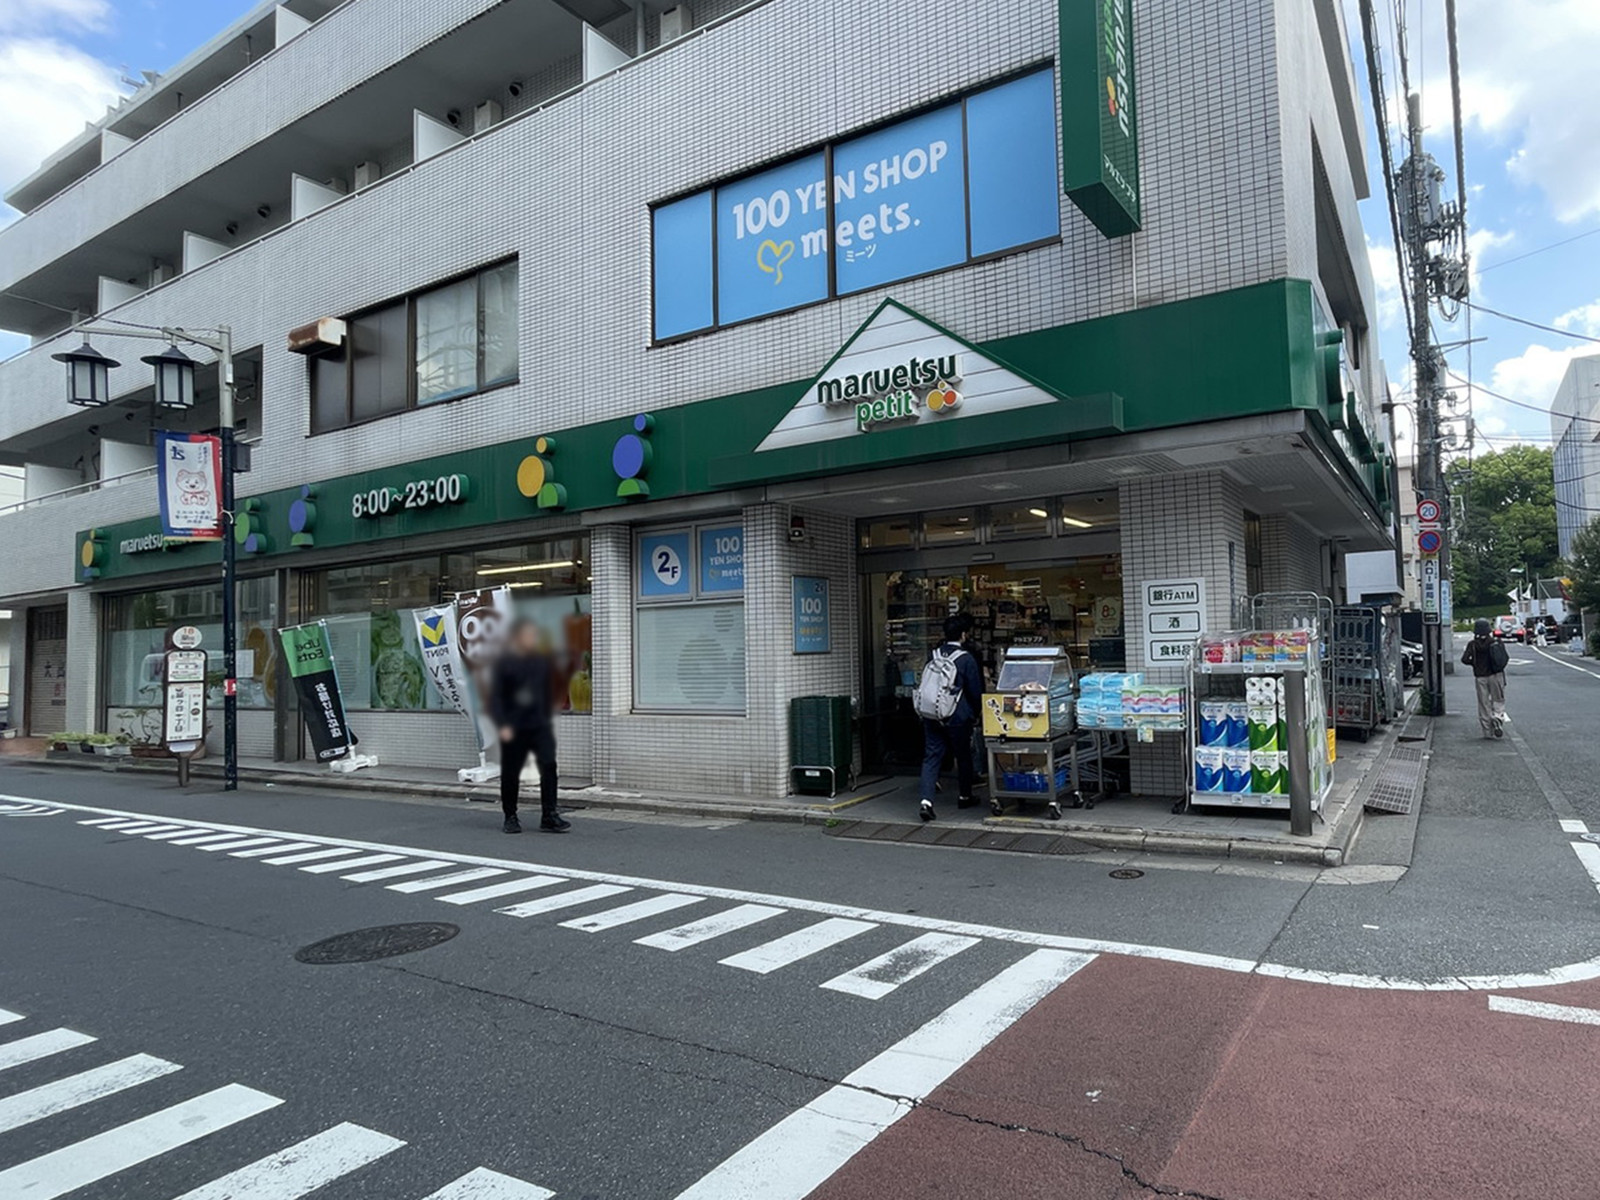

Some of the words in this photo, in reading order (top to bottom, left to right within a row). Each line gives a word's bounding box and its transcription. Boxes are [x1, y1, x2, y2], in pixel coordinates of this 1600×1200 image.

[1114, 0, 1130, 138] aruetsu
[732, 189, 790, 240] 100
[795, 170, 856, 214] YEN
[863, 141, 948, 194] SHOP
[845, 243, 877, 263] ミーツ
[818, 354, 957, 403] maruetsu
[857, 390, 913, 432] petit
[1422, 506, 1436, 517] 20
[120, 534, 164, 554] maruetsu
[714, 536, 741, 554] 100
[726, 554, 743, 564] SHO
[1153, 589, 1195, 601] 銀行ATM
[800, 597, 822, 614] 100
[1168, 616, 1180, 629] 酒
